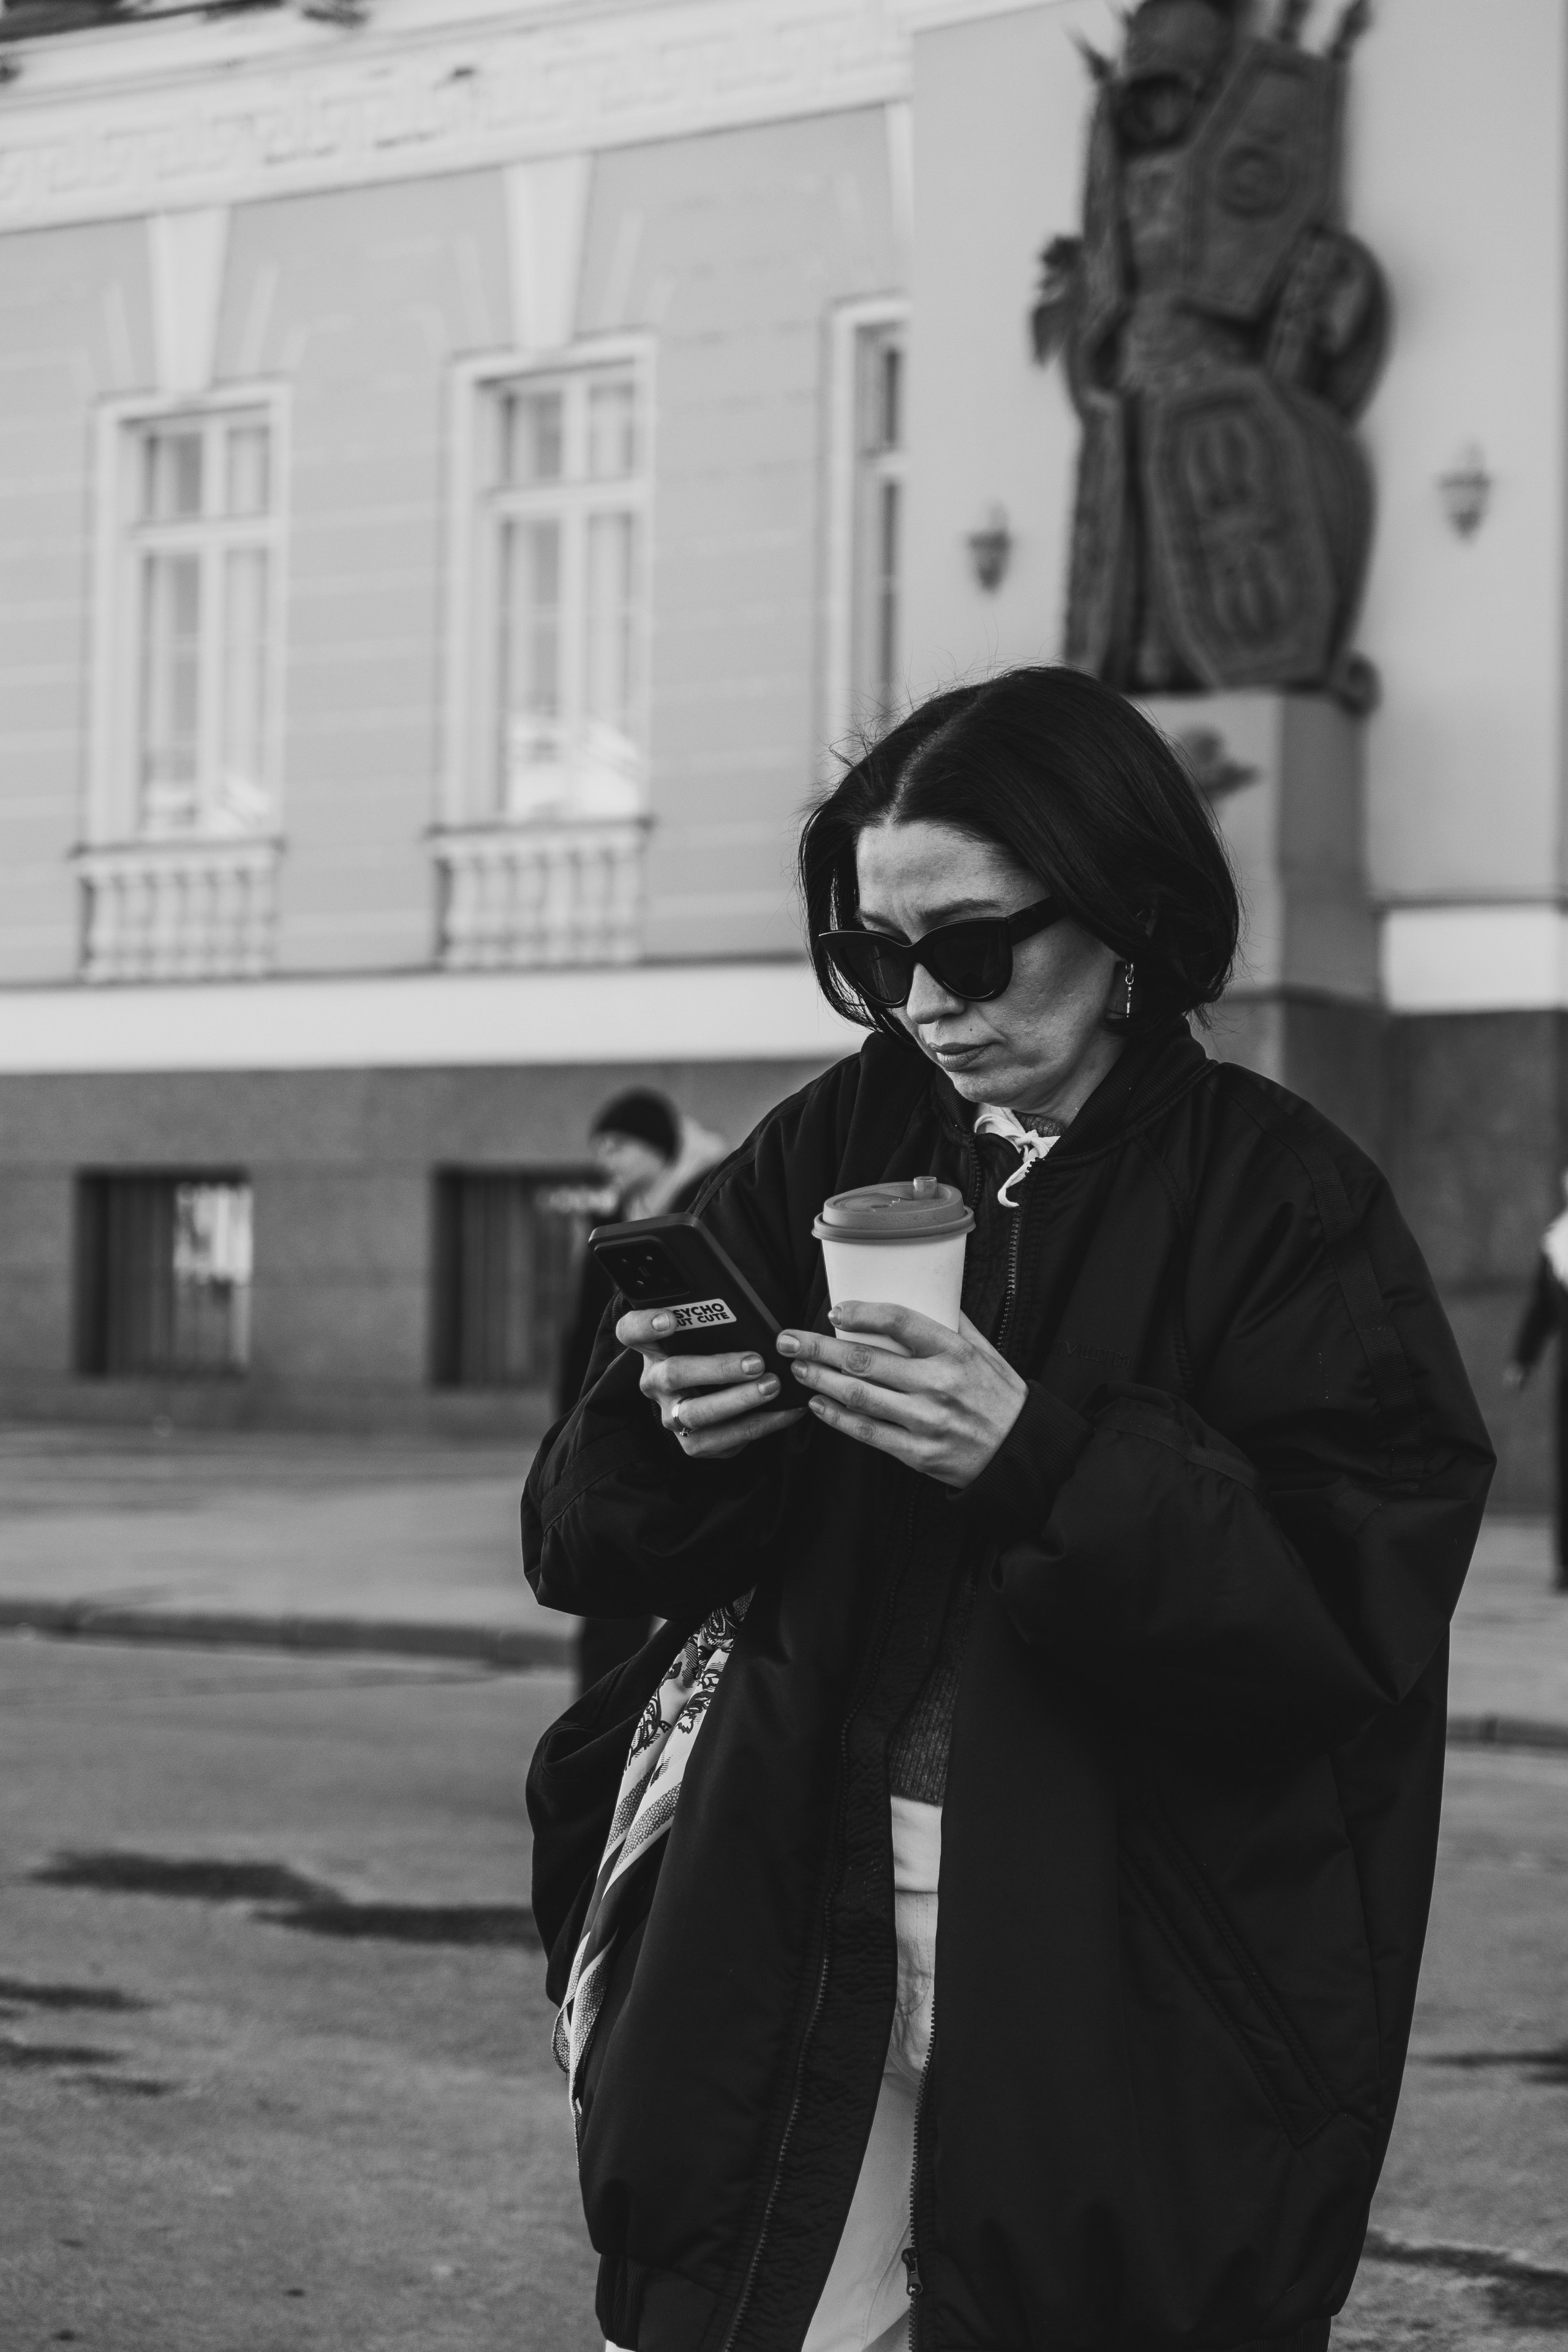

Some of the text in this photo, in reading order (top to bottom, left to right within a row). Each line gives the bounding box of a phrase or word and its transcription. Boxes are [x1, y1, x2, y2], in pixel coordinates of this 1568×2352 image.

[673, 1303, 725, 1319] SYCHO
[677, 1312, 730, 1327] UT CUTE
